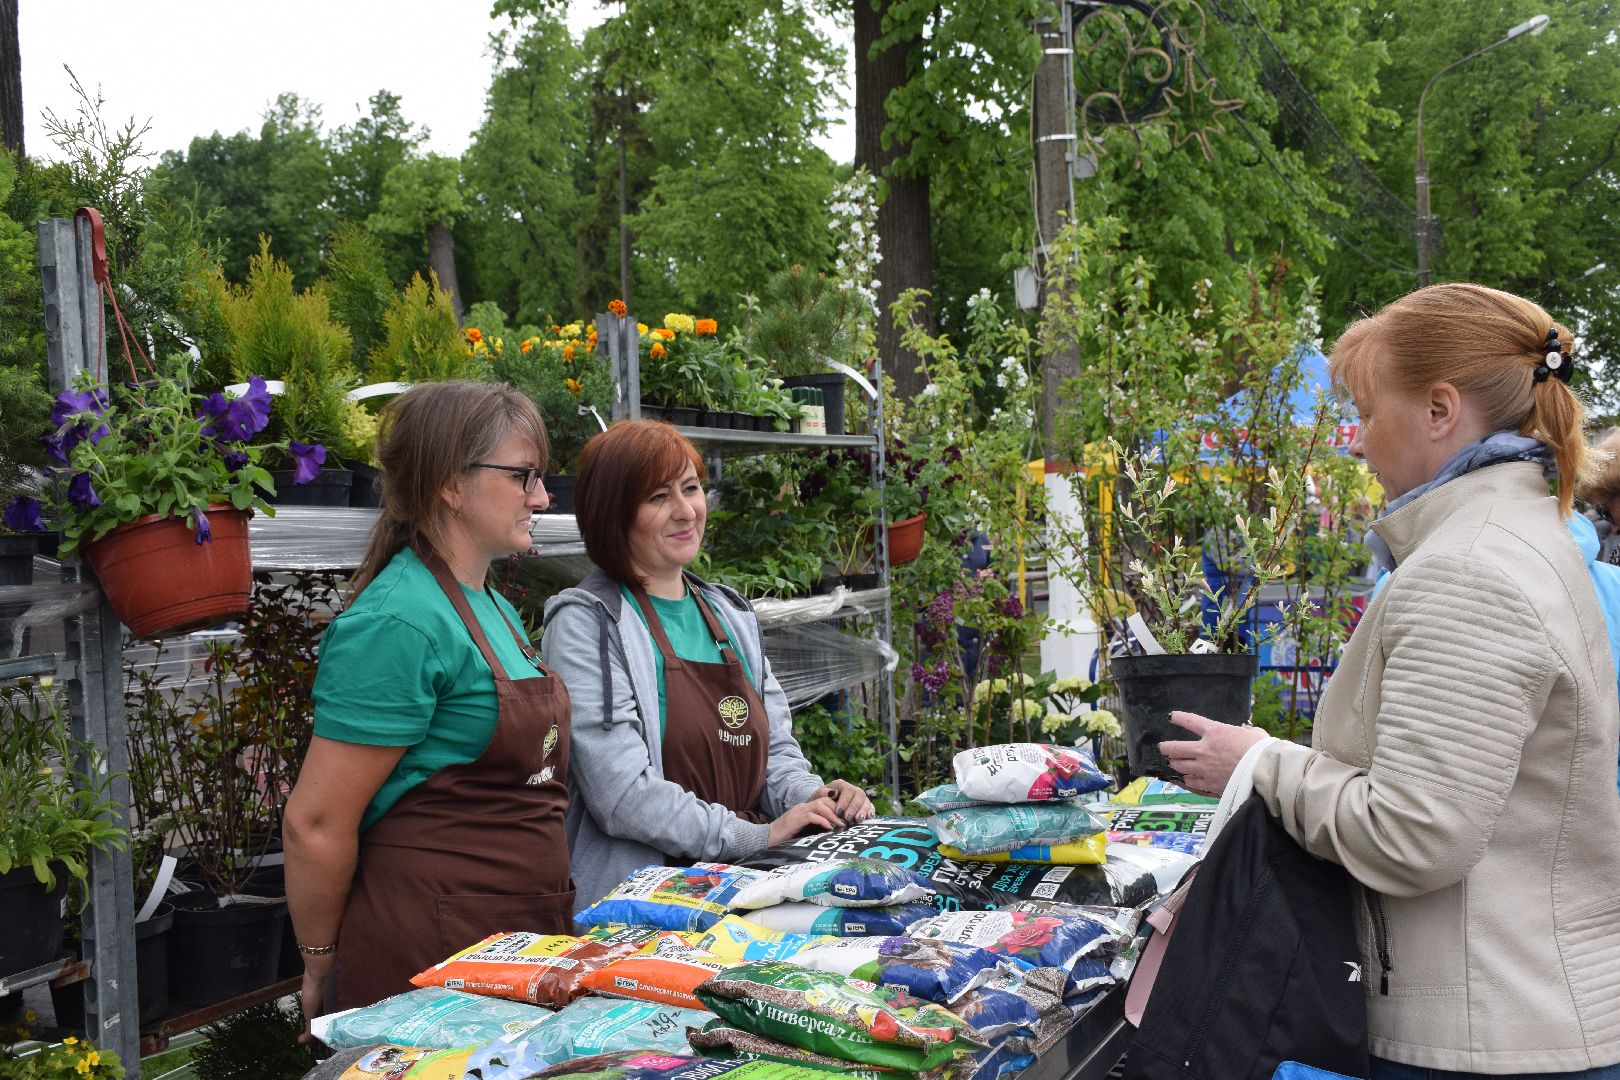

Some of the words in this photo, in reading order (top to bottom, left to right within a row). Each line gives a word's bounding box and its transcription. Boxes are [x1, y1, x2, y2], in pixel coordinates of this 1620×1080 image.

[806, 825, 870, 862] ПОЧВО
[826, 825, 892, 861] ГРУНТ
[859, 827, 940, 869] 3D
[933, 894, 960, 912] 3D
[755, 998, 847, 1038] Универсал
